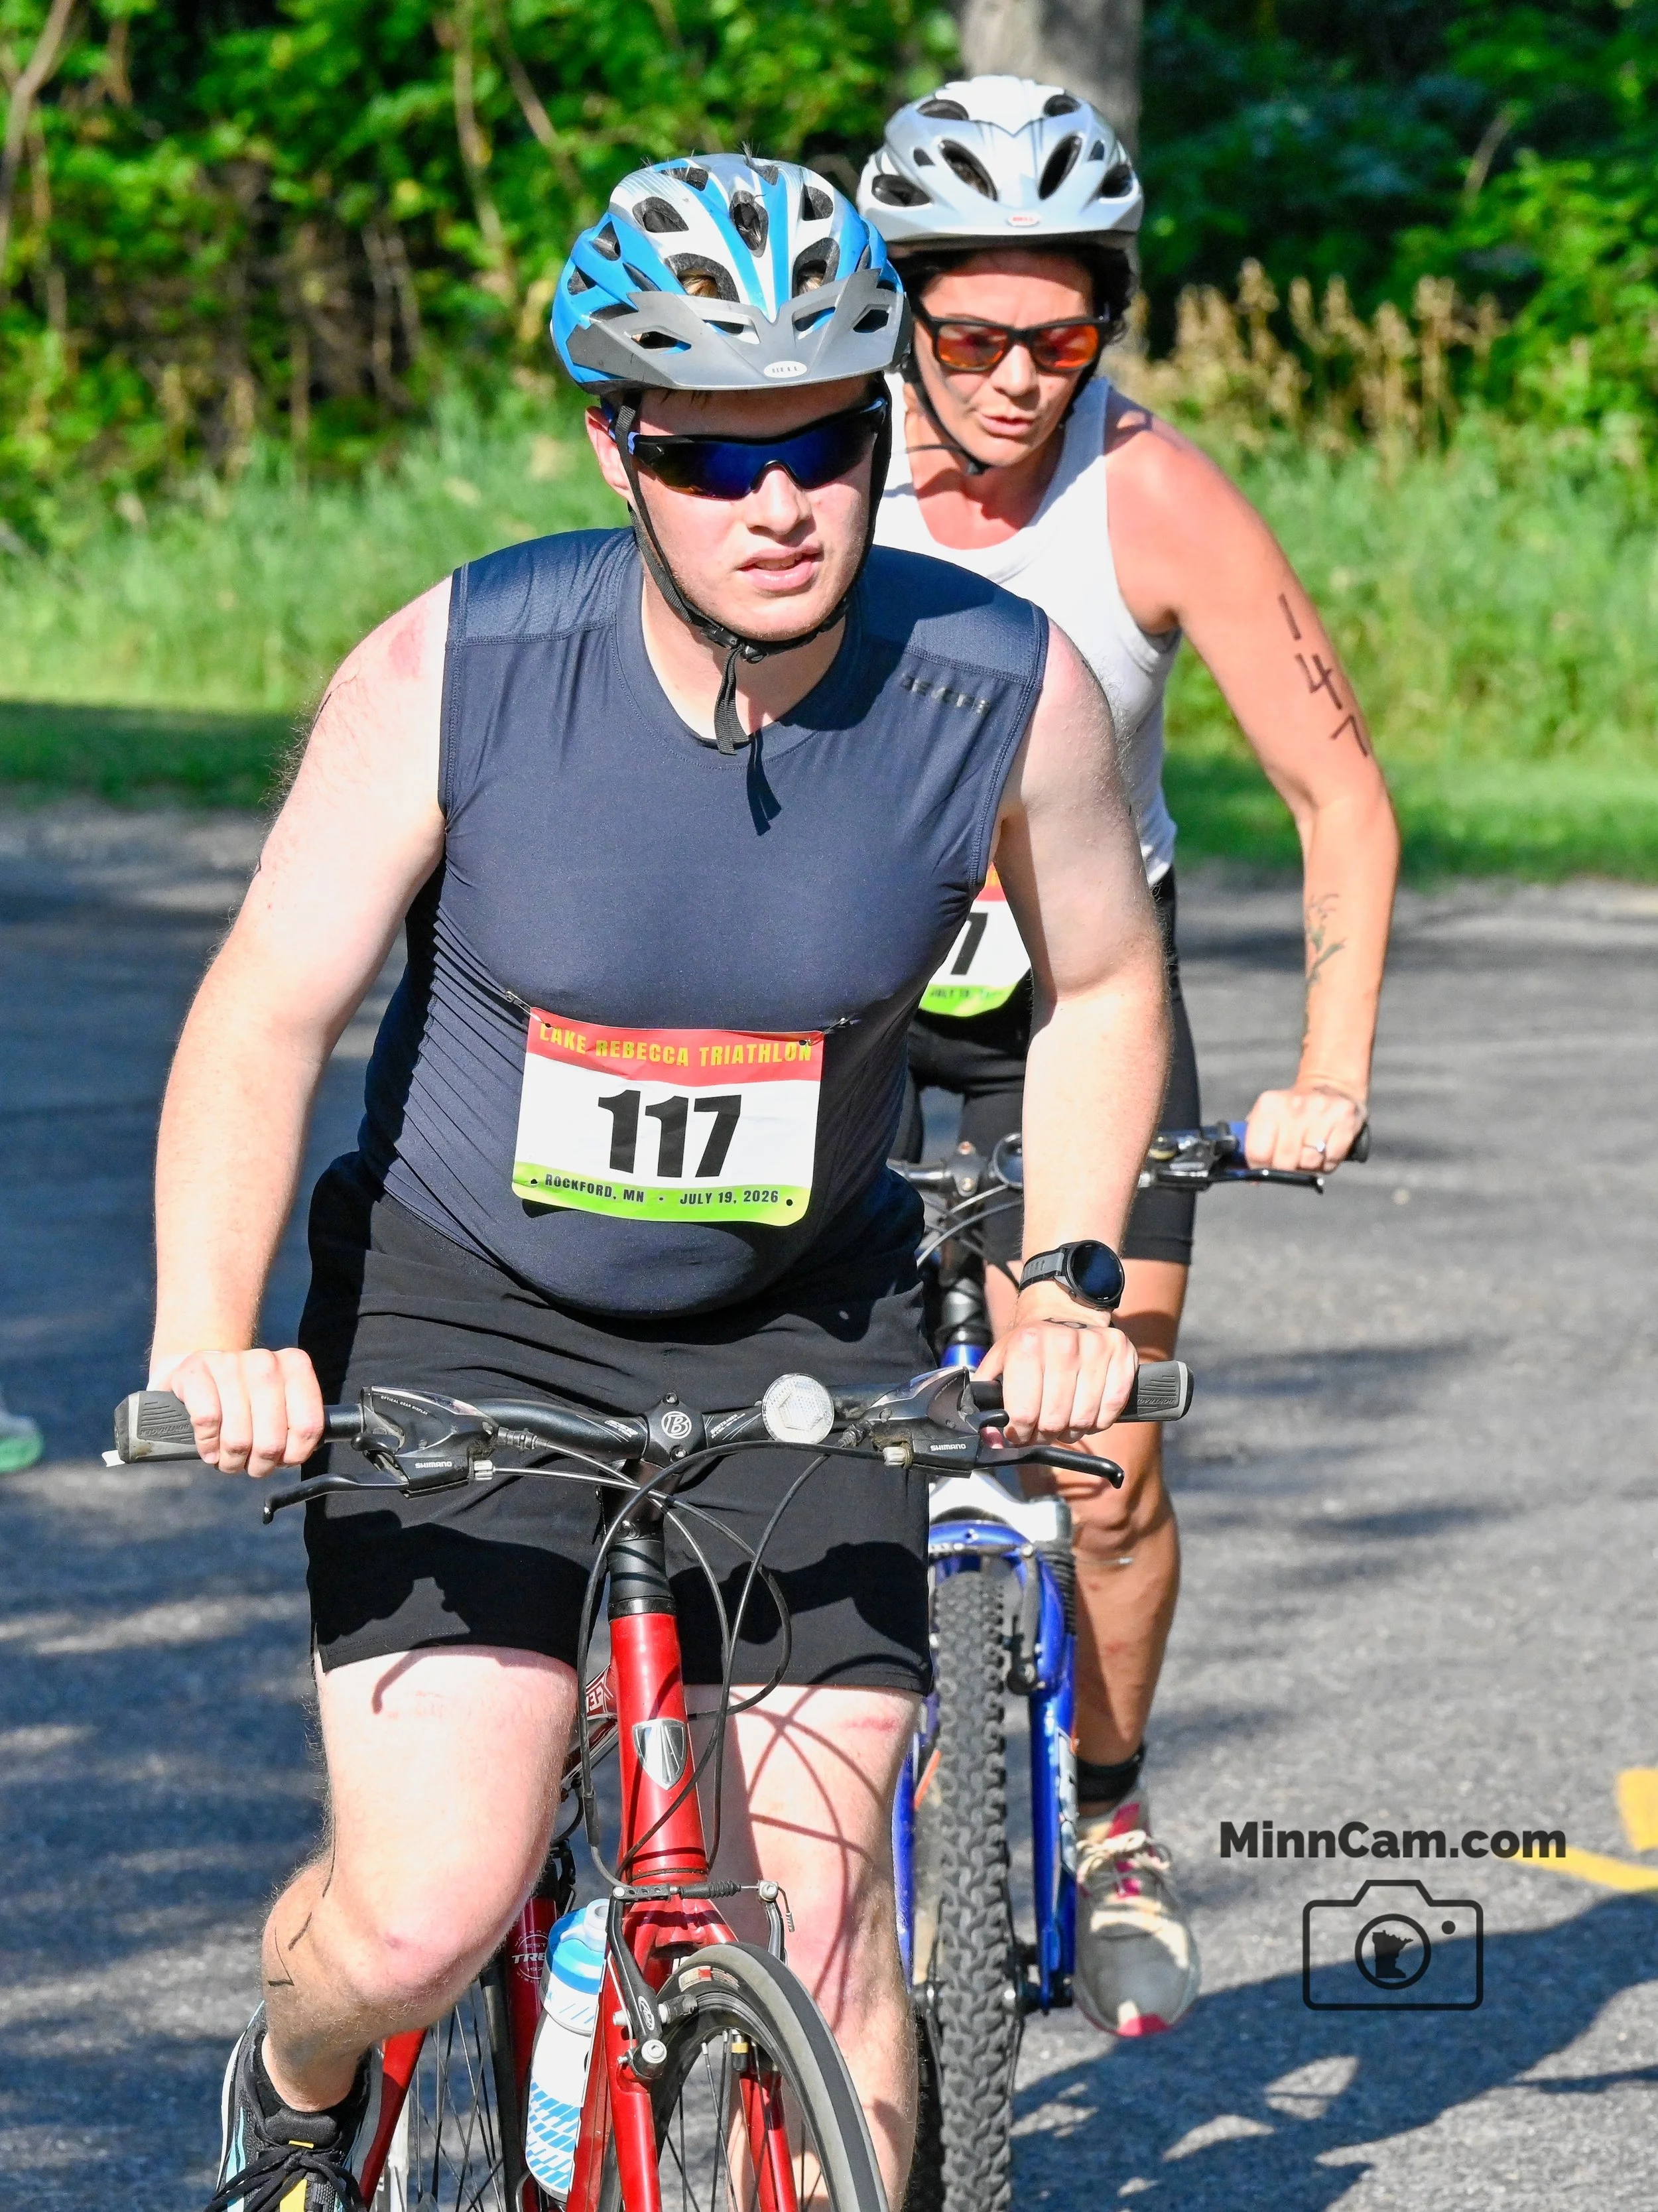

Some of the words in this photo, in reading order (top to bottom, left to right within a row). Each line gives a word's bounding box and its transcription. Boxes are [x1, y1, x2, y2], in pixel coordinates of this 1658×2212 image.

[1277, 592, 1368, 757] 147
[539, 1023, 587, 1055] LAKE
[596, 1039, 689, 1067] REBECCA
[699, 1041, 812, 1067] TRIATHLON
[598, 1089, 742, 1178] 117
[544, 1173, 617, 1200] ROCKFORD,
[623, 1189, 645, 1203] MN
[680, 1193, 712, 1204] JULY
[718, 1191, 737, 1204] 19,
[743, 1190, 779, 1203] 2026
[930, 1443, 967, 1452] SHIMANO
[414, 1461, 453, 1469] SHIMANO
[511, 1952, 546, 1964] TRE
